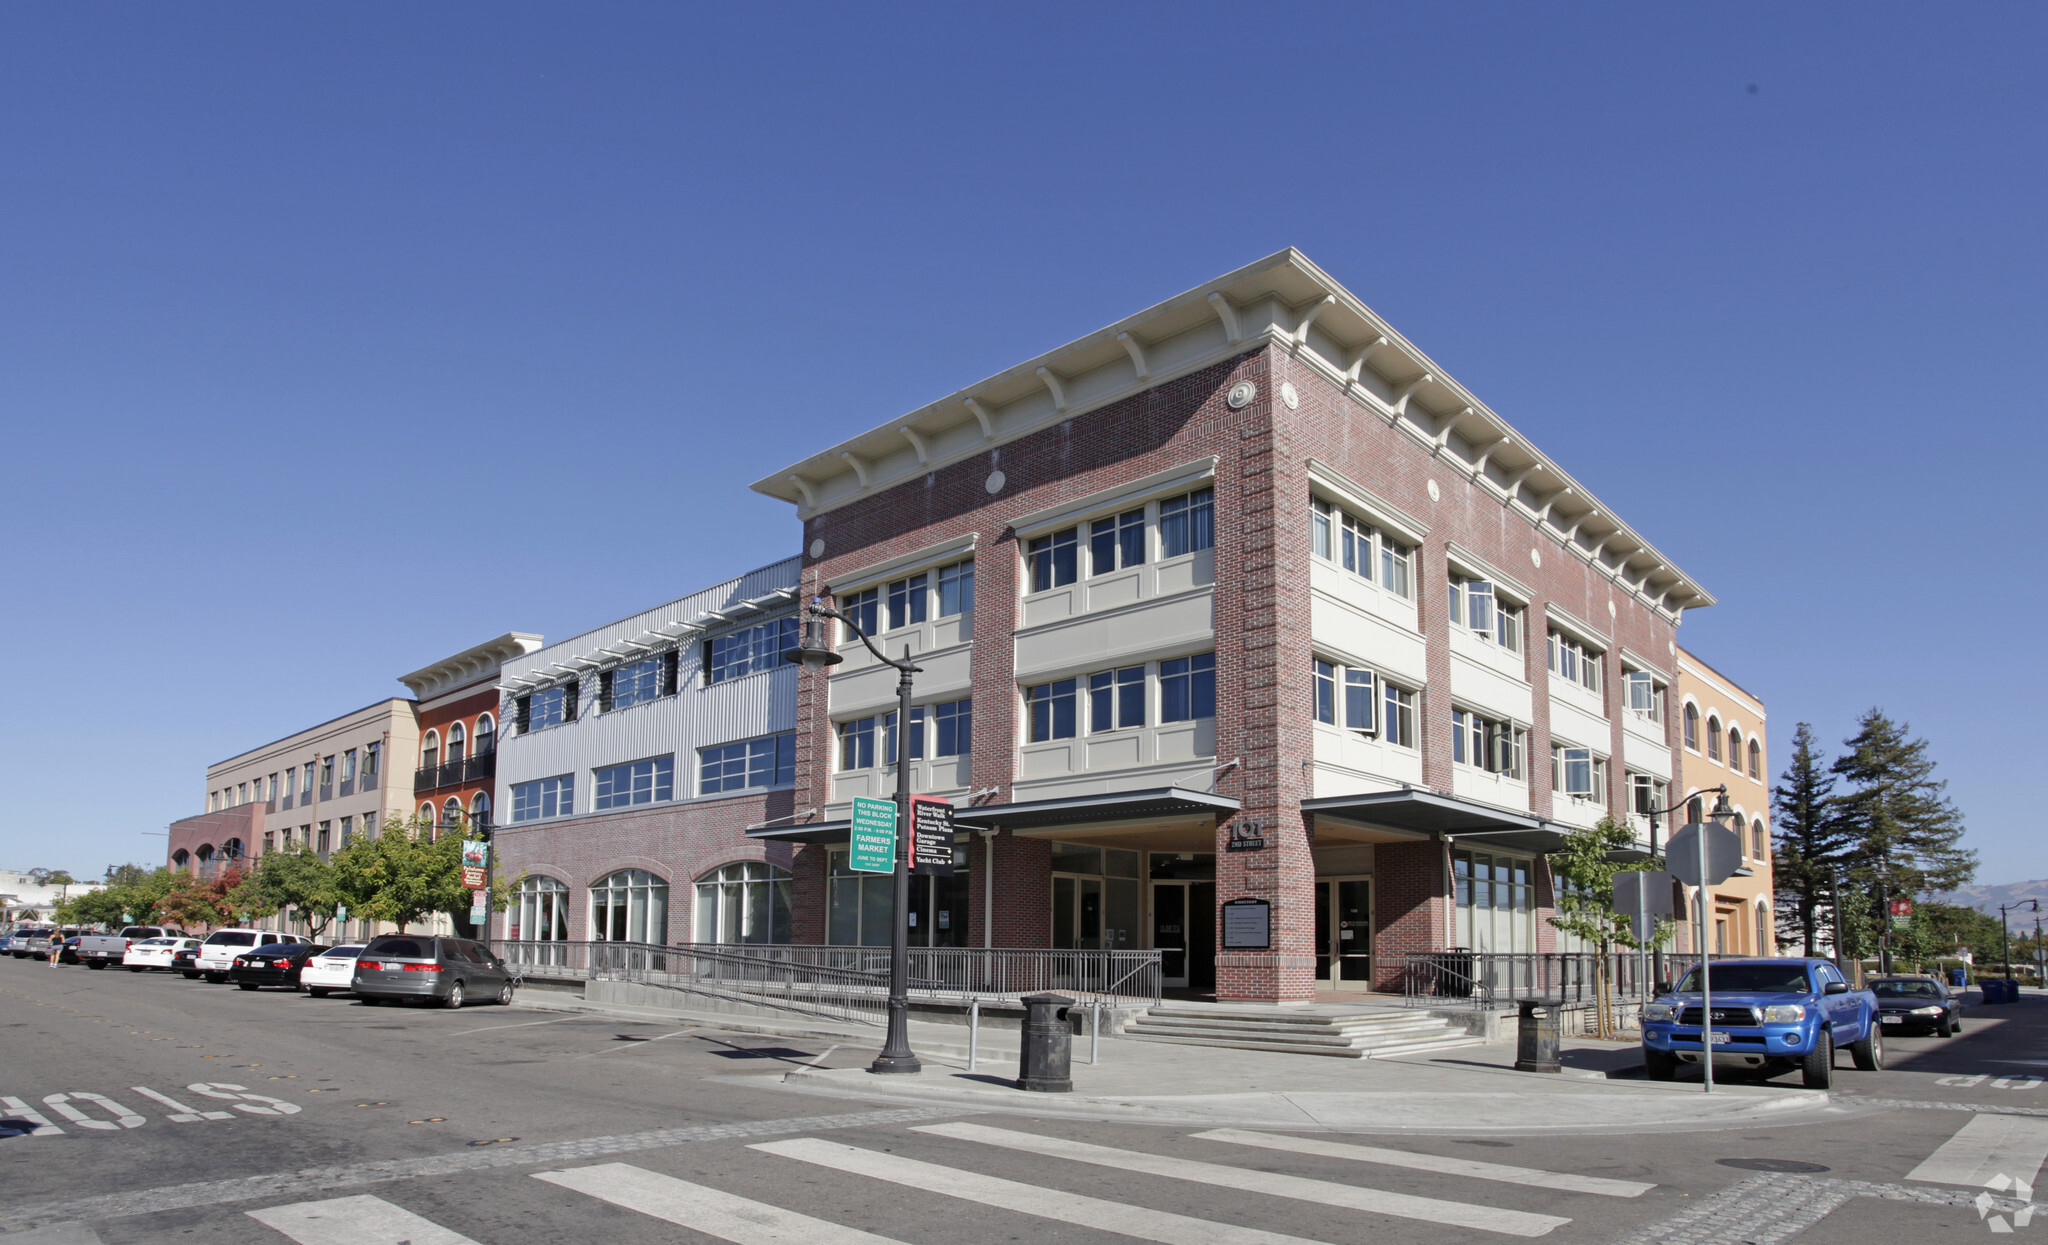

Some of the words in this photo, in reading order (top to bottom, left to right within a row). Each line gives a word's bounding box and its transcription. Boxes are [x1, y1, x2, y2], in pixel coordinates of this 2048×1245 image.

[868, 803, 893, 812] PARKING
[917, 804, 945, 813] Waterfront
[856, 818, 892, 828] WEDNESDAY
[917, 817, 942, 826] Kentucky
[1230, 820, 1262, 840] 101
[856, 834, 891, 845] FARMERS
[917, 832, 945, 840] Downtown
[858, 844, 889, 853] MARKET
